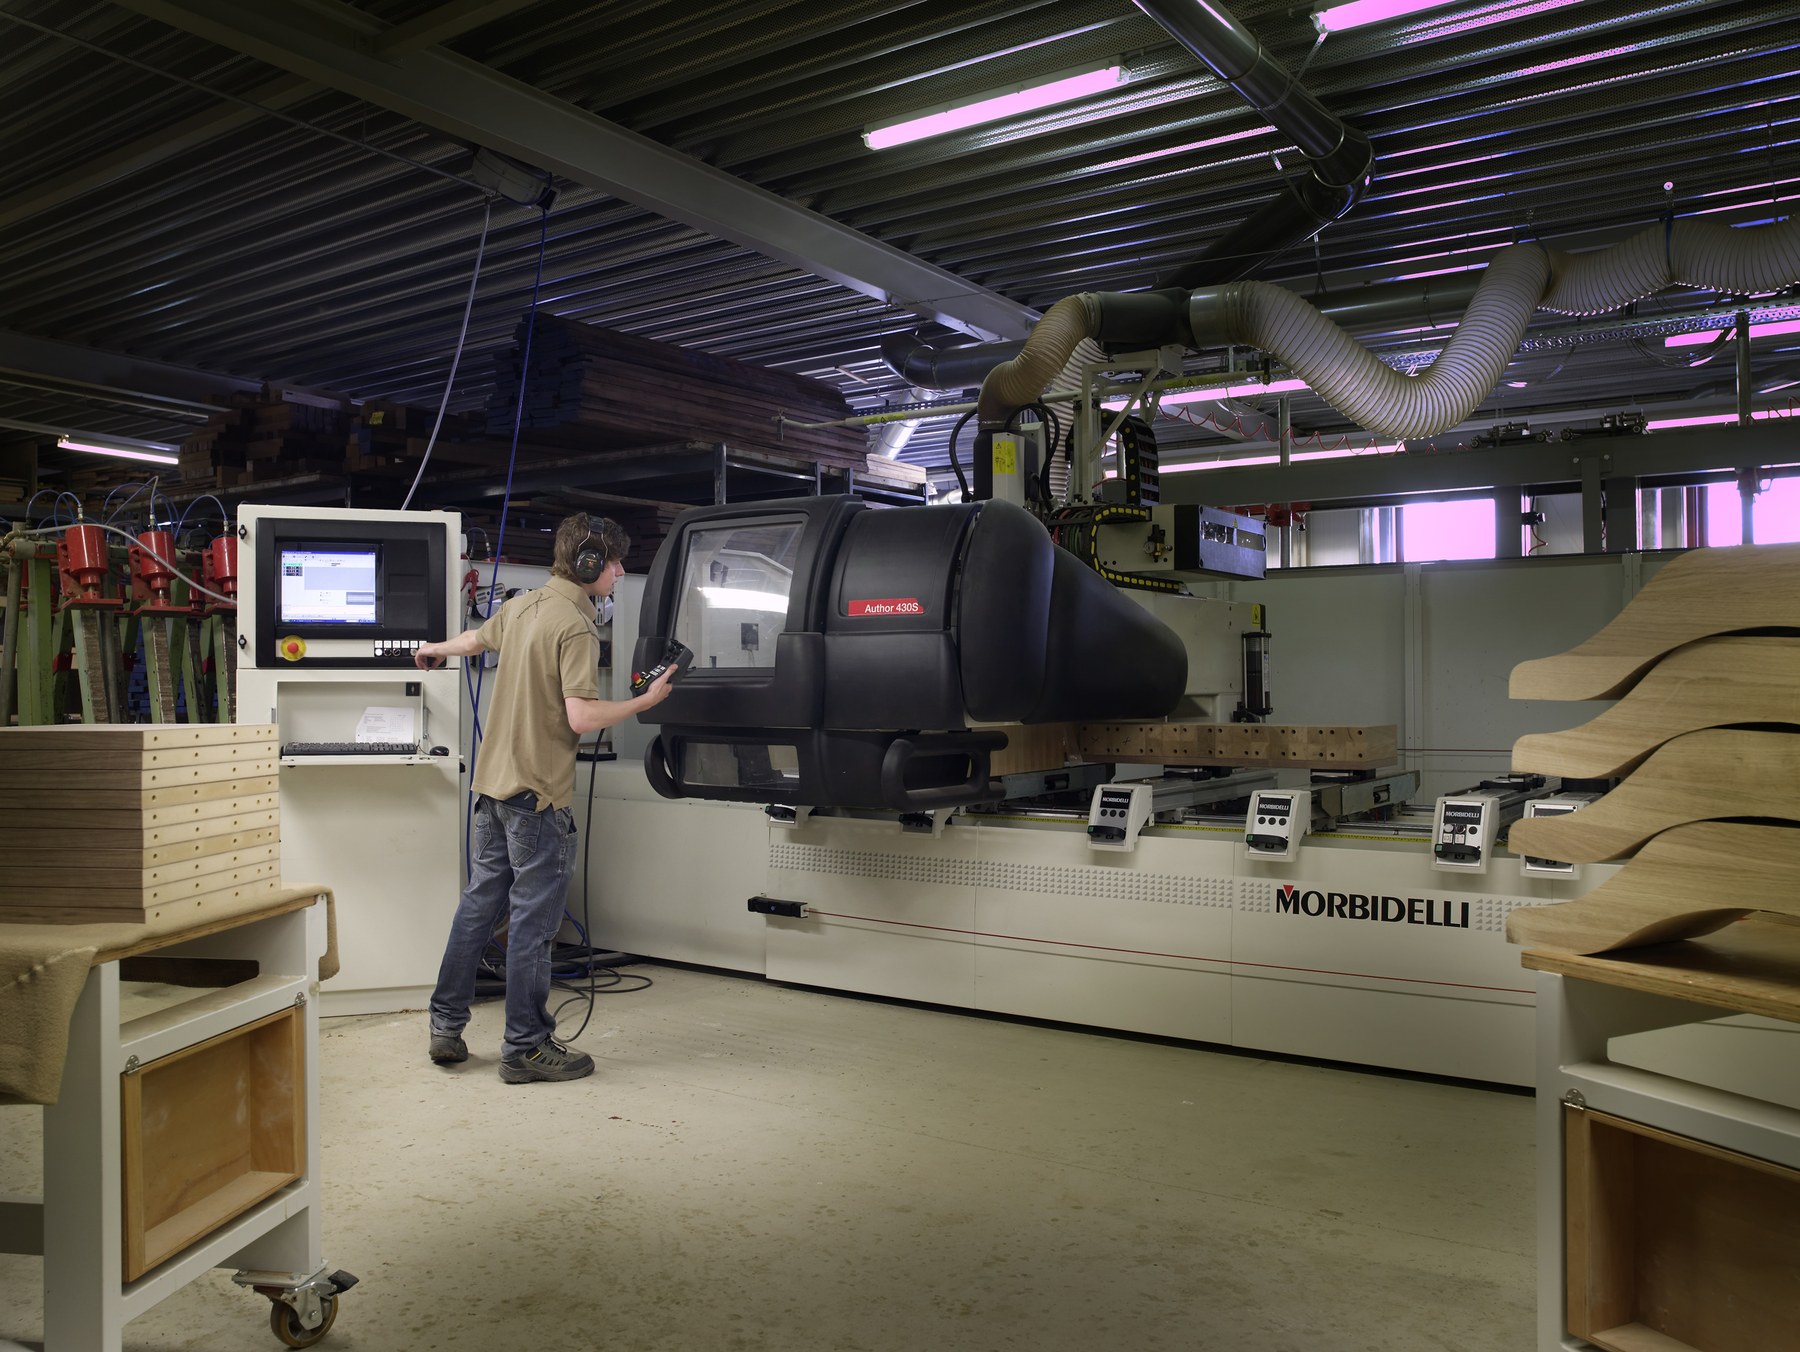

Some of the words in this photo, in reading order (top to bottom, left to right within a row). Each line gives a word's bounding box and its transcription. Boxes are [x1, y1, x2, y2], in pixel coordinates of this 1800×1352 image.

[864, 604, 893, 613] Author
[896, 603, 919, 612] 430S
[1276, 887, 1469, 928] MORBIDELLI
